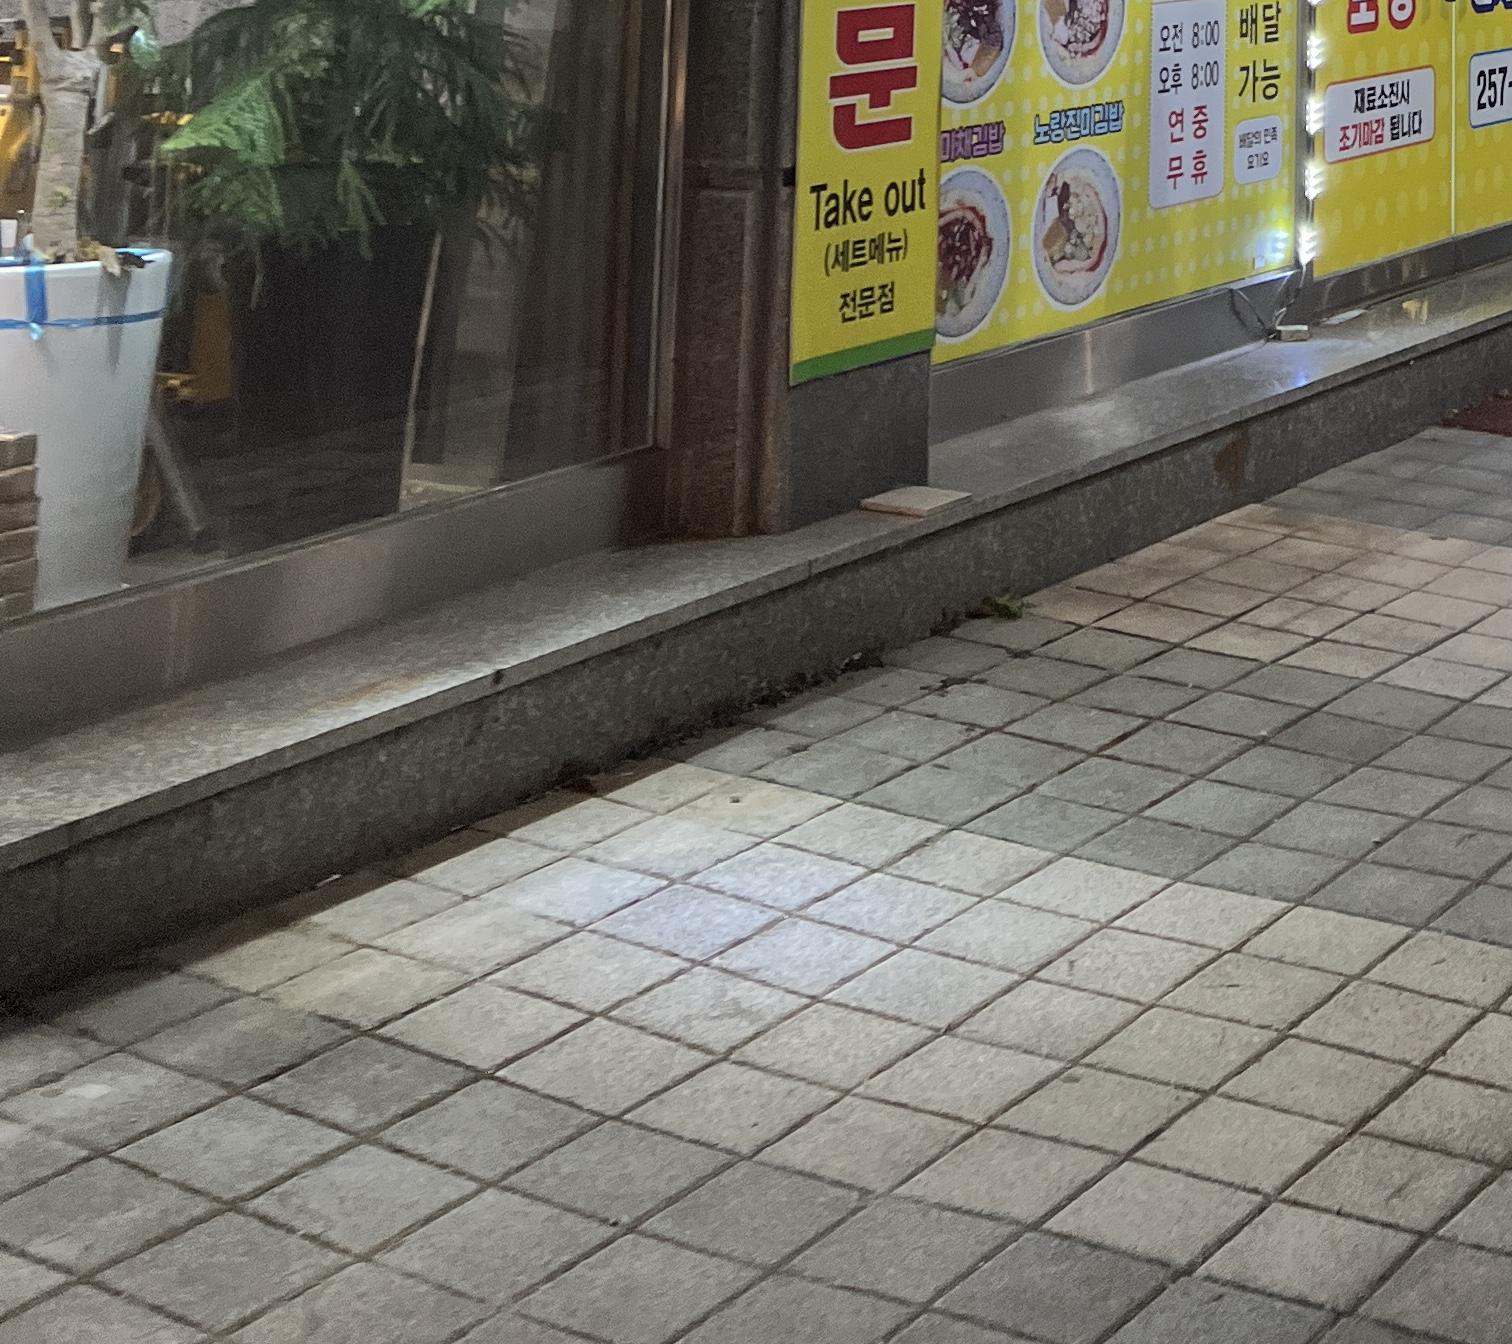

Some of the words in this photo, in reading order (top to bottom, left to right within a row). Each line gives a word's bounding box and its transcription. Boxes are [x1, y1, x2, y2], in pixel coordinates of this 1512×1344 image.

[1159, 23, 1184, 54] 오전
[1191, 20, 1220, 49] 8:00
[1239, 0, 1282, 47] 배달
[1158, 63, 1183, 95] 오후
[1191, 60, 1220, 90] 8:00
[1239, 59, 1282, 103] 가능
[1353, 78, 1411, 114] 재료소진시
[1168, 104, 1209, 145] 연중
[1339, 117, 1386, 153] 조기마감
[1390, 110, 1423, 141] 됩니다
[1166, 150, 1208, 191] 무휴
[1247, 151, 1270, 170] 요기요
[809, 178, 874, 232] Take
[884, 167, 927, 217] out
[823, 228, 909, 277] (세트메뉴)
[838, 280, 895, 324] 전문점
